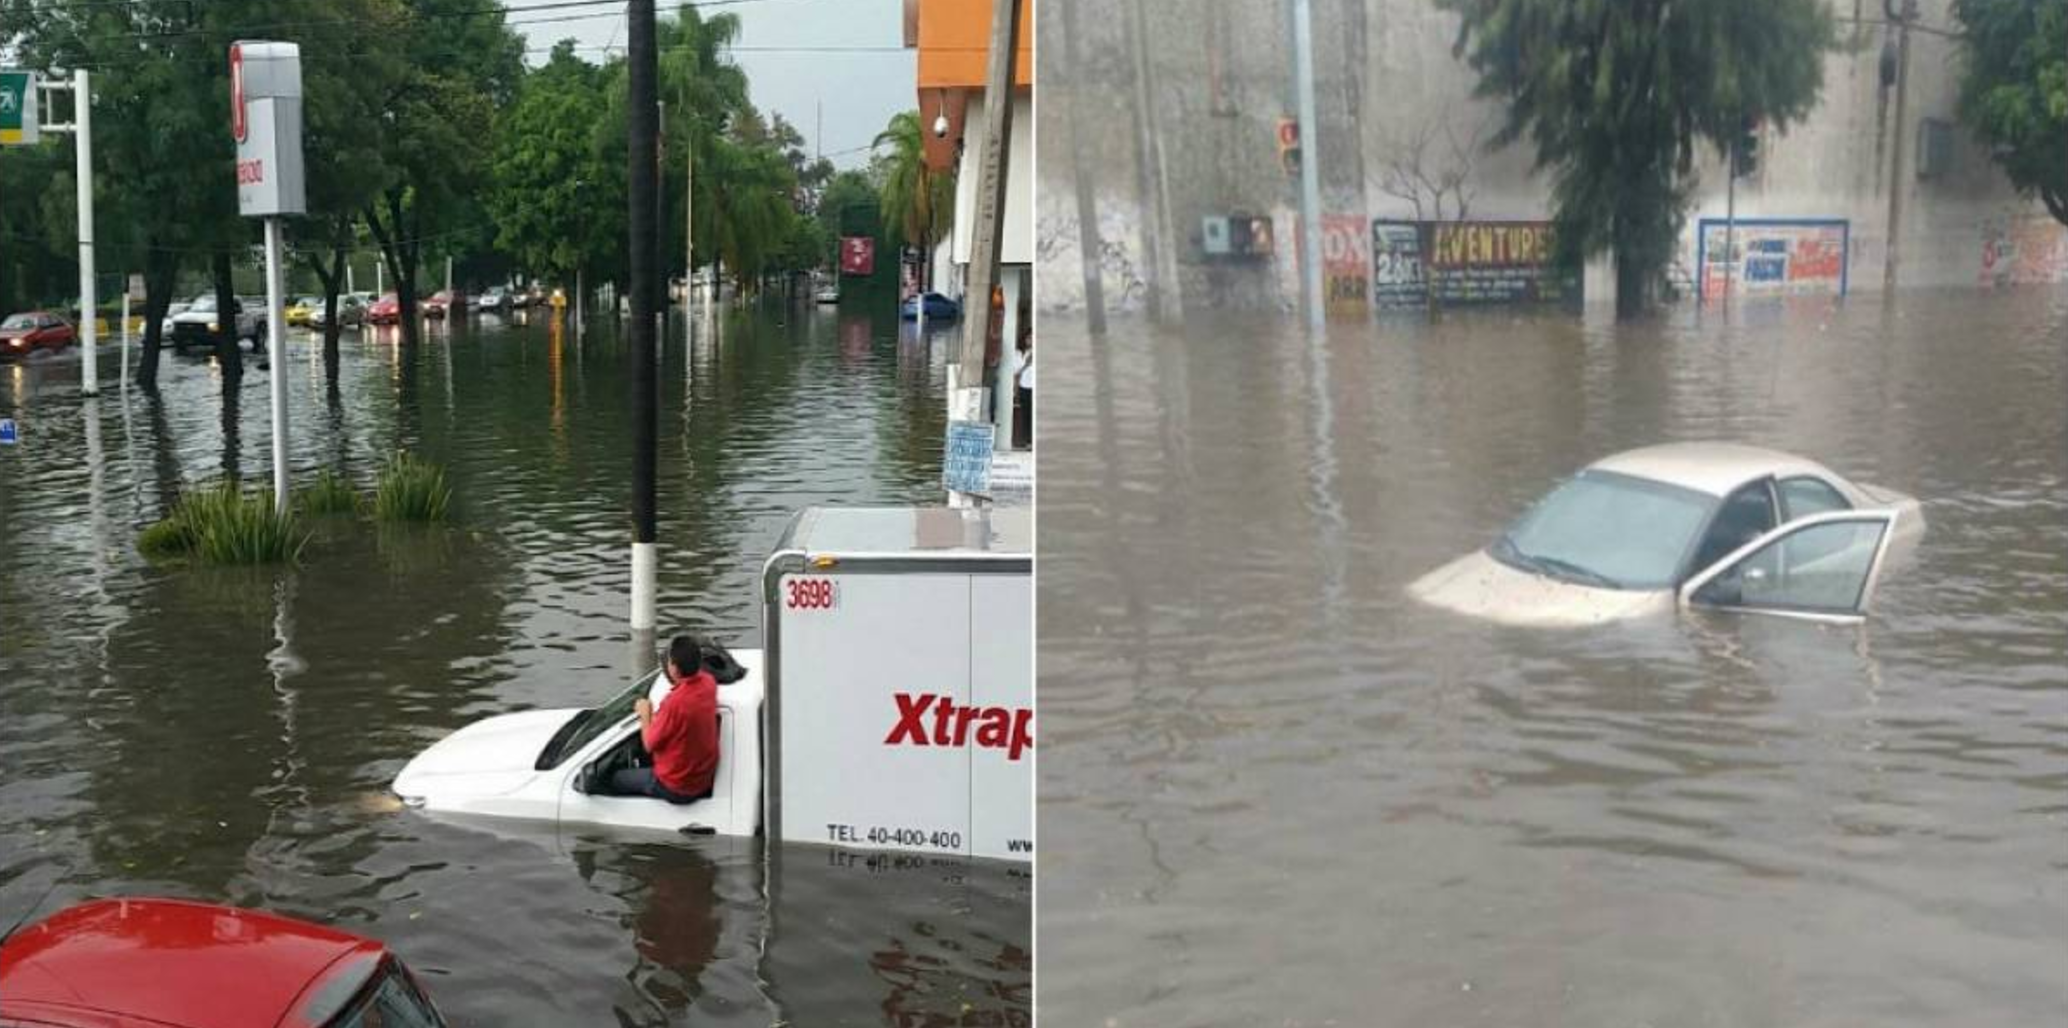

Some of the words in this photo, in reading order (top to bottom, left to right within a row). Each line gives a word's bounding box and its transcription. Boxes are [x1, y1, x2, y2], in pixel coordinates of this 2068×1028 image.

[1433, 226, 1558, 264] AVENTURE
[787, 579, 831, 608] 3698
[884, 693, 1033, 760] Xtrap
[868, 827, 961, 848] 40-400-400
